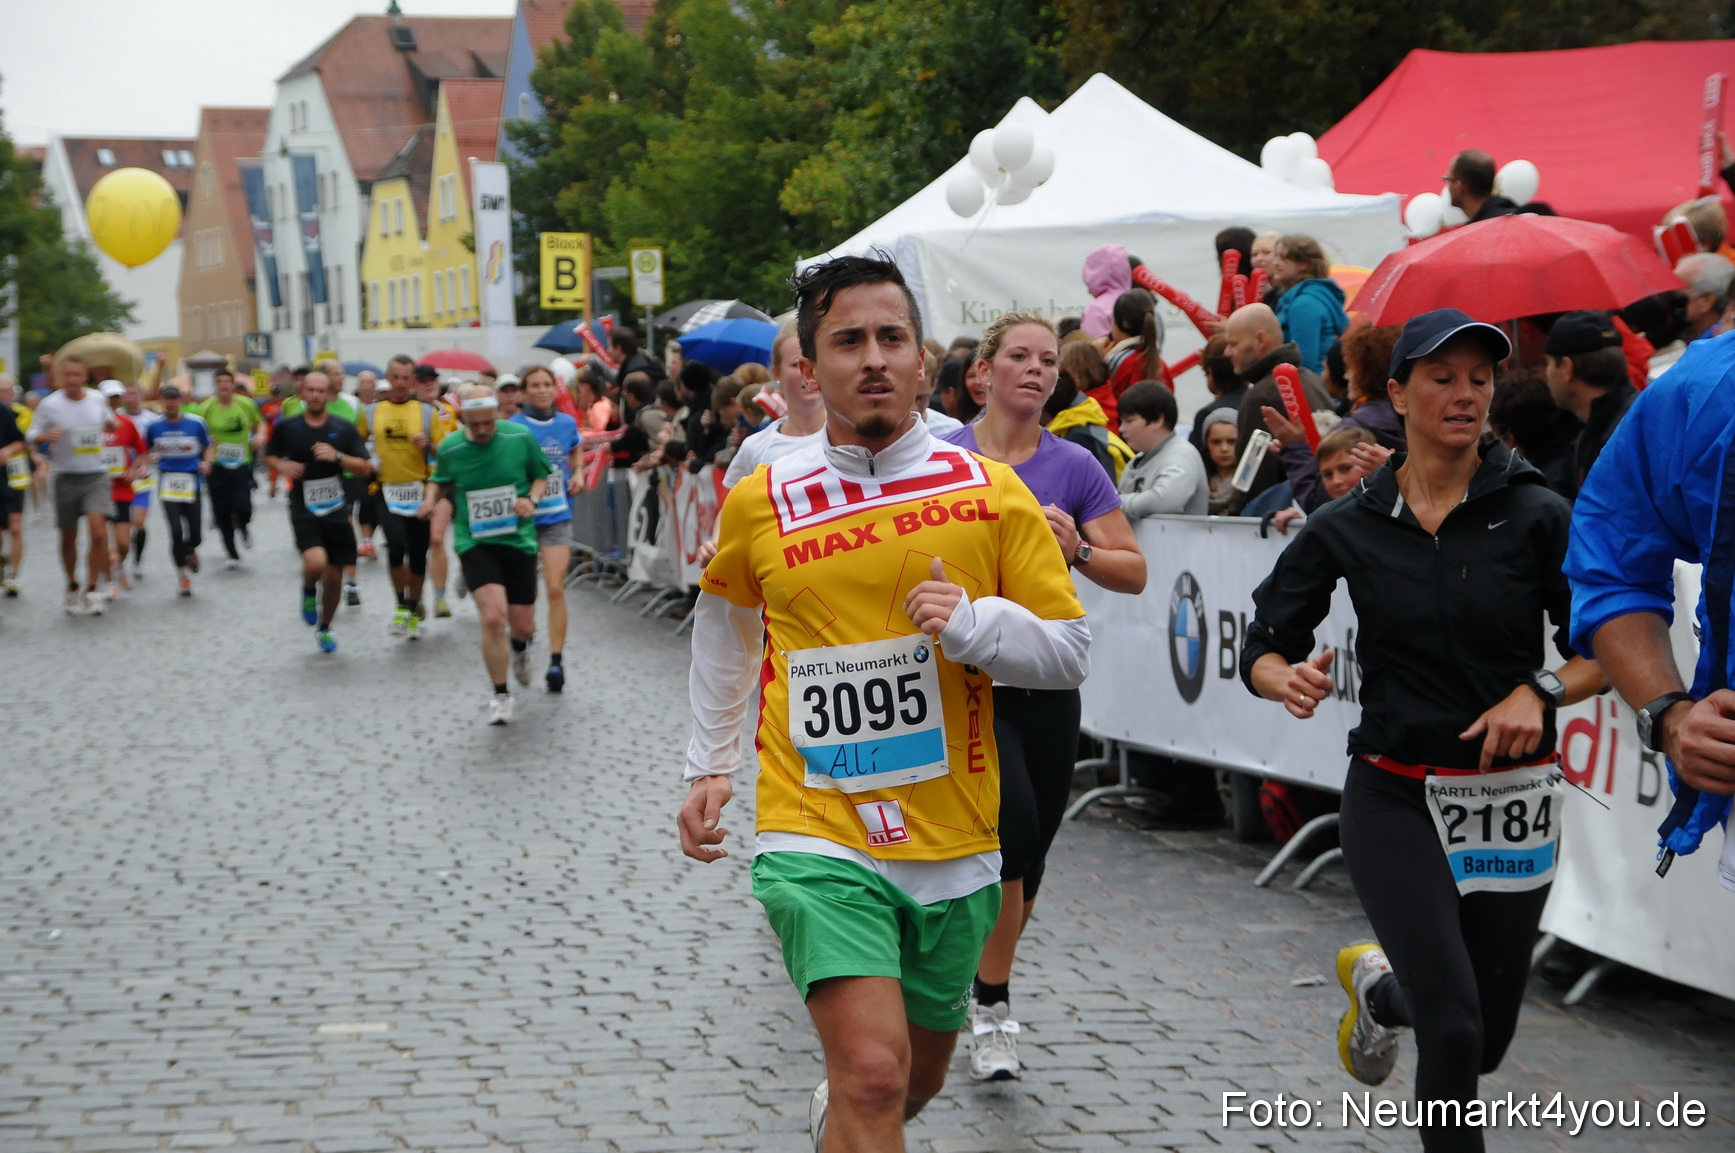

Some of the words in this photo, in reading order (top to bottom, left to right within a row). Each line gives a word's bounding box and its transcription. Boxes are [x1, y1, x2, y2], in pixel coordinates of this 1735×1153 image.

[546, 235, 584, 250] Block
[555, 256, 577, 291] B
[472, 498, 513, 519] 2507
[783, 522, 882, 570] MAX
[892, 498, 999, 537] BÖGL
[790, 661, 833, 679] PARTL
[835, 652, 909, 675] Neumarkt
[803, 671, 928, 739] 3095
[1481, 779, 1542, 797] Neumarkt
[1442, 794, 1552, 846] 2184
[1463, 855, 1535, 874] Barbara
